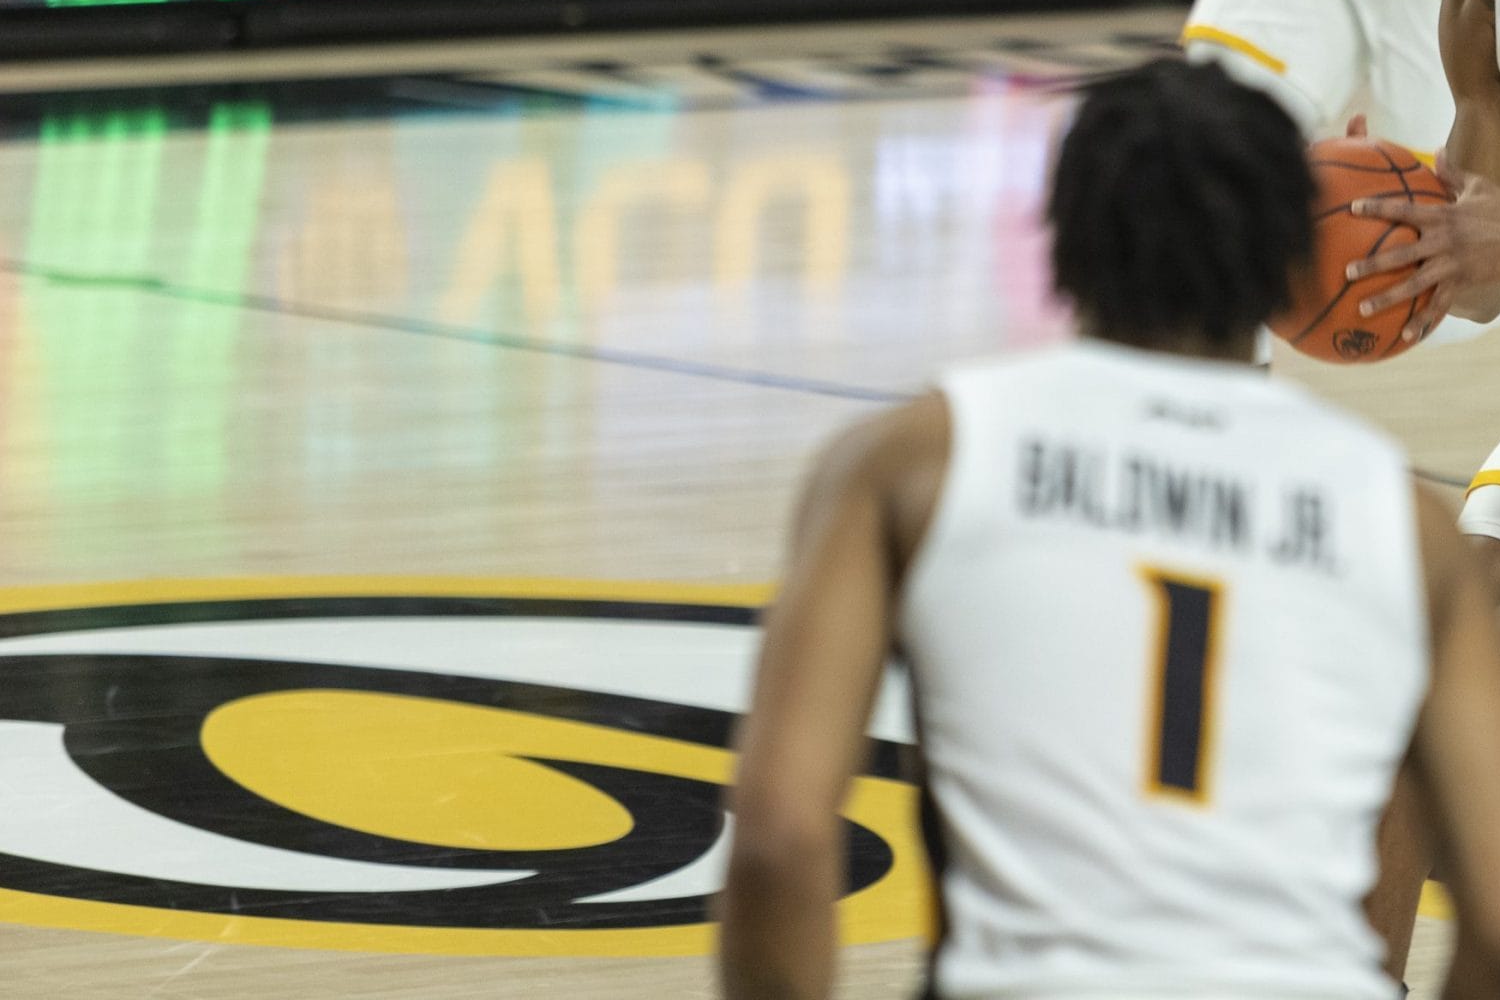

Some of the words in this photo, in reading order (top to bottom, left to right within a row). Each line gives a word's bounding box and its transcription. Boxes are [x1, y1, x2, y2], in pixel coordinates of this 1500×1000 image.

[1013, 436, 1256, 556] BALDWIN
[1265, 482, 1347, 578] JR.
[1140, 562, 1227, 808] 1
